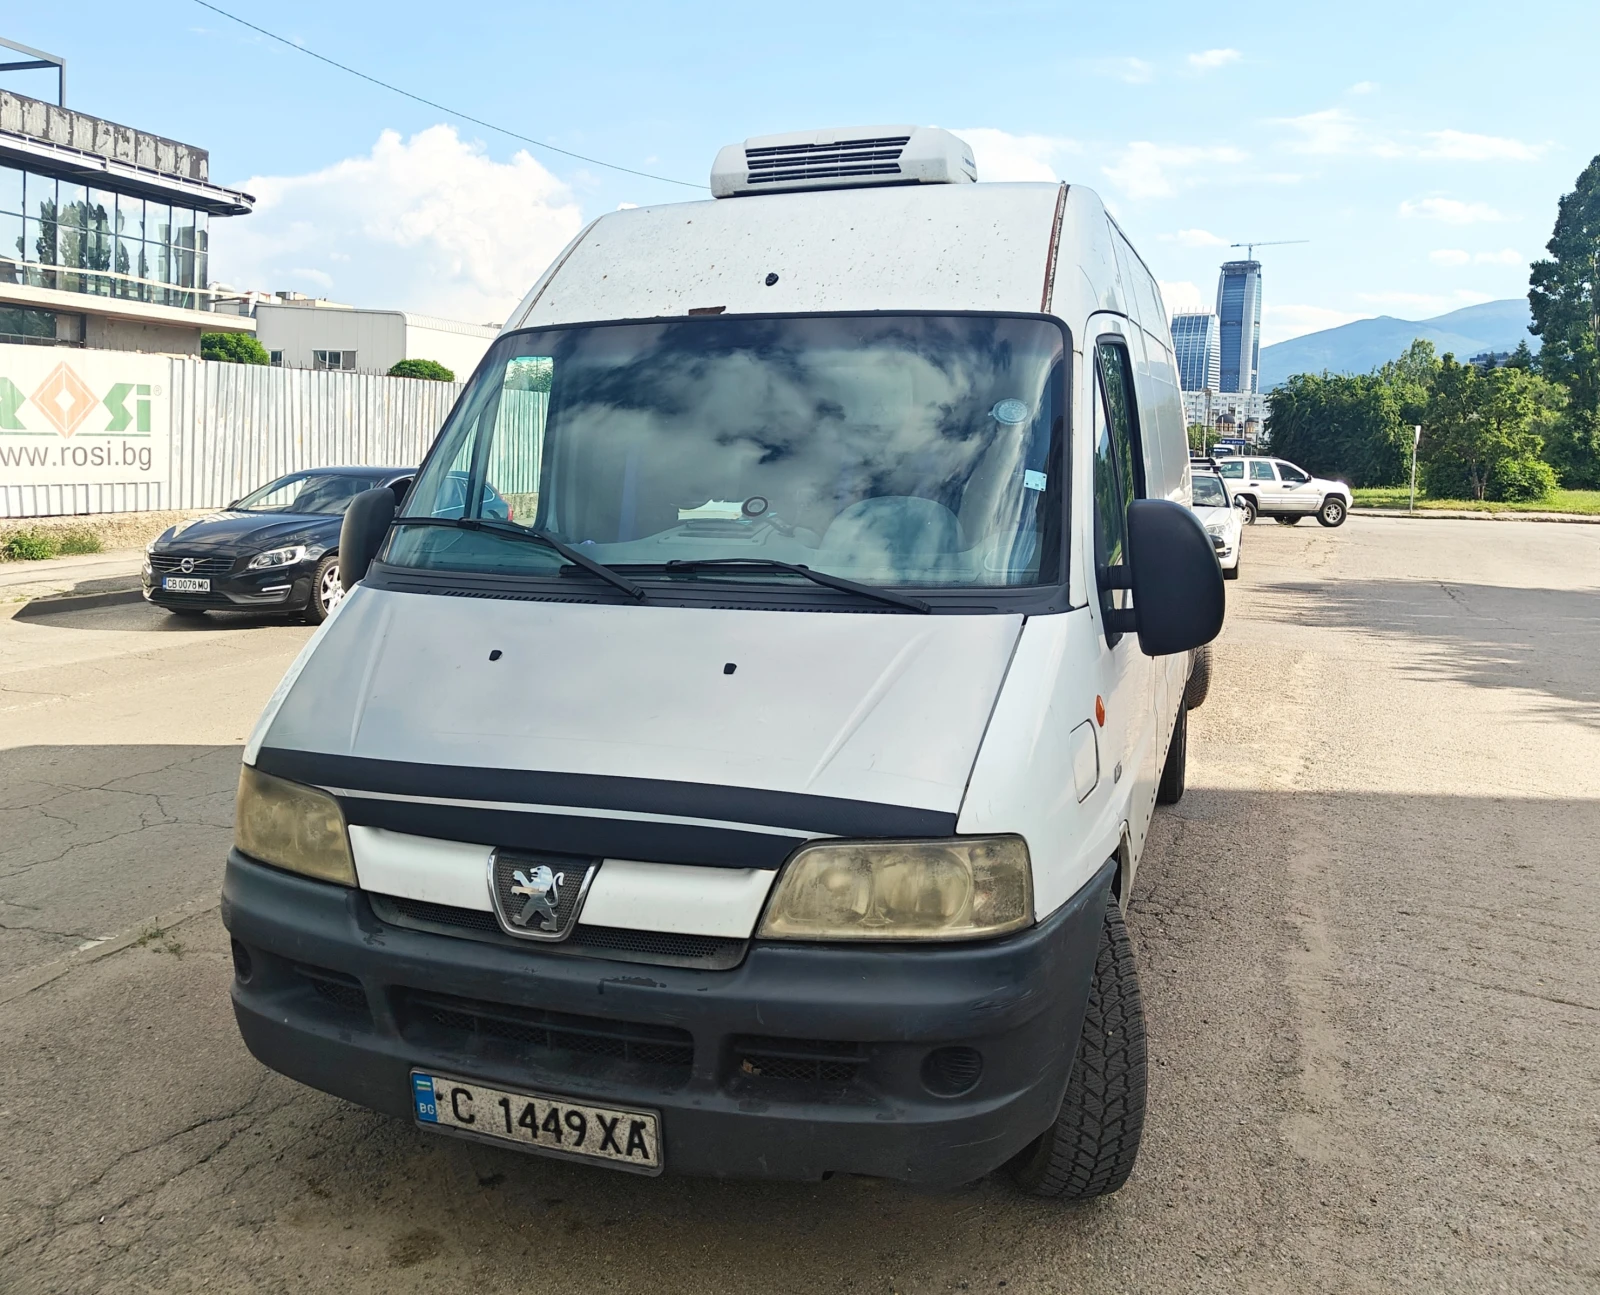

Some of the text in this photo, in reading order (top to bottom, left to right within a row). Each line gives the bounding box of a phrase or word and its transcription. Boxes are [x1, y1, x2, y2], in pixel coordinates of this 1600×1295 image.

[419, 1102, 435, 1115] BG
[451, 1087, 650, 1160] C 1449 XA
